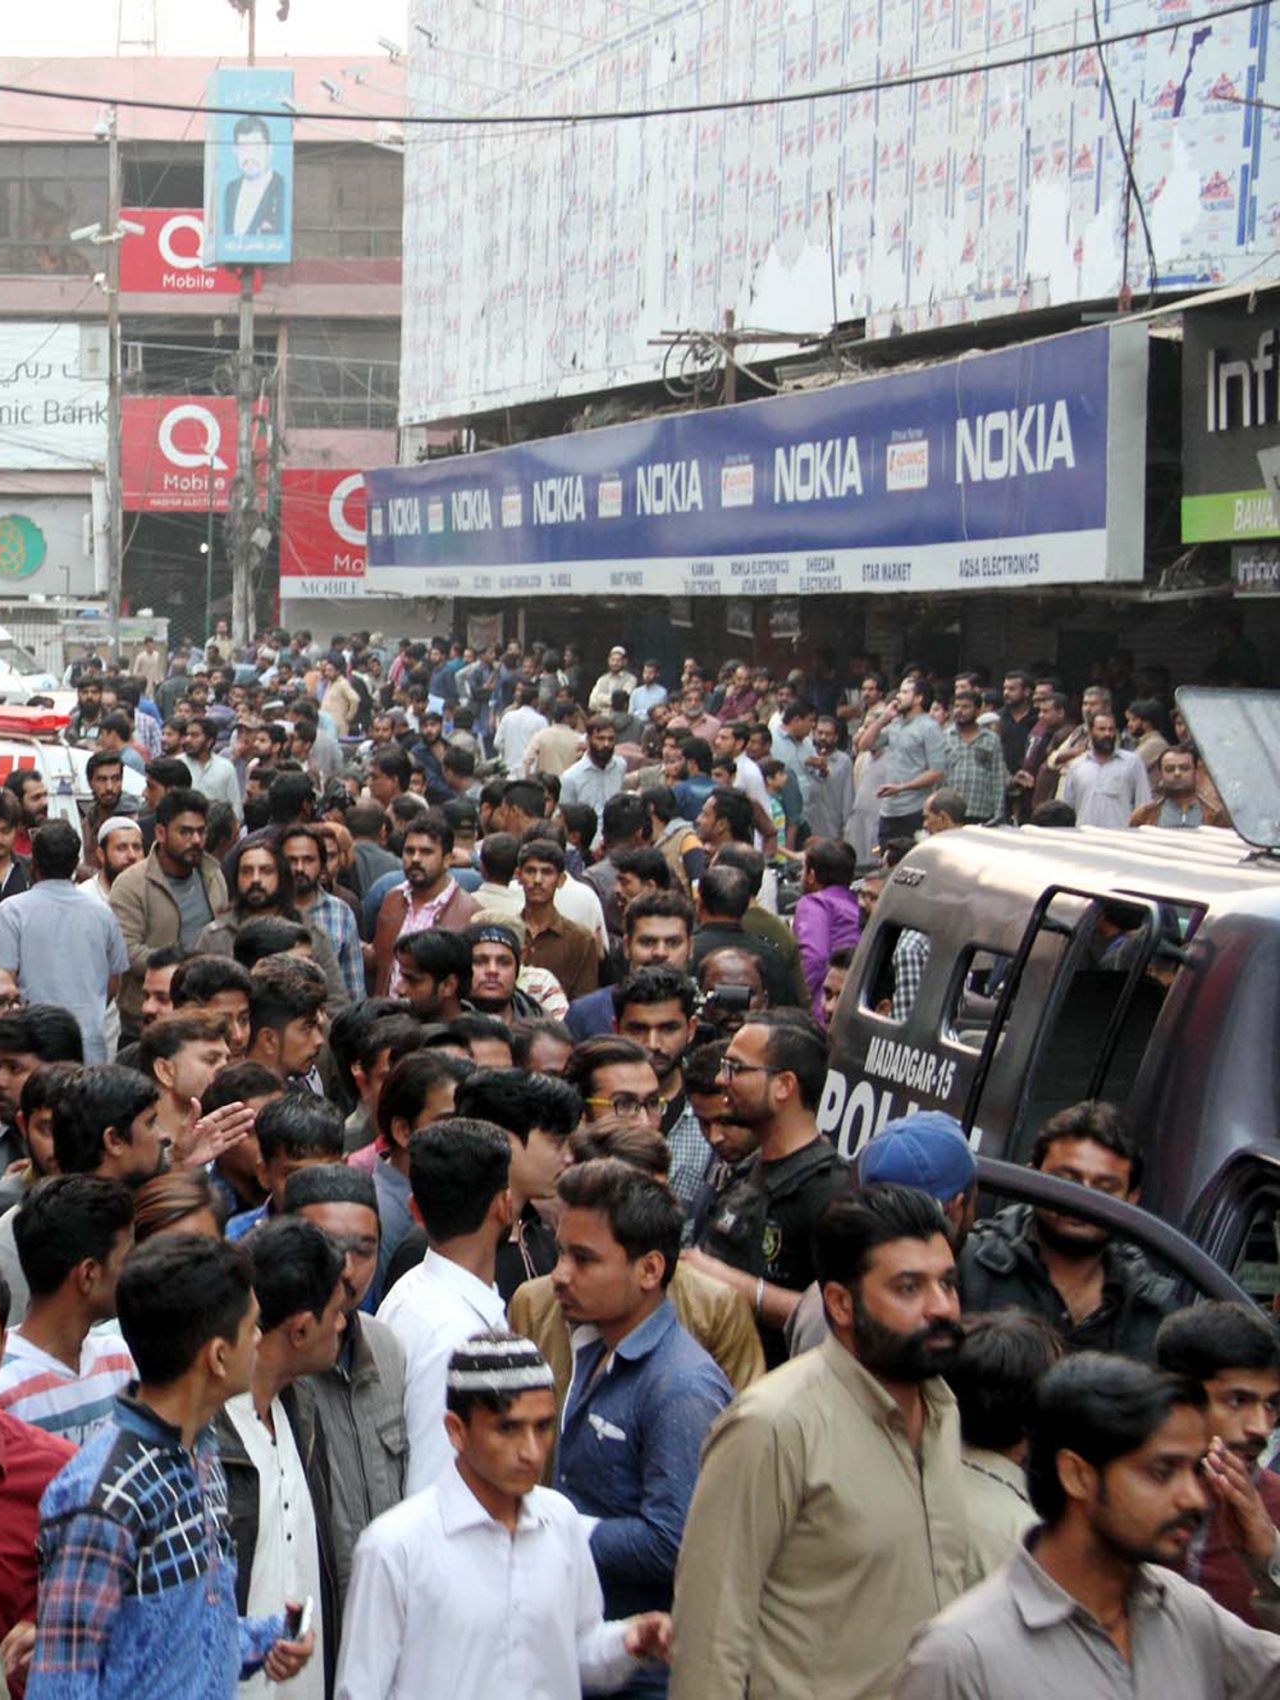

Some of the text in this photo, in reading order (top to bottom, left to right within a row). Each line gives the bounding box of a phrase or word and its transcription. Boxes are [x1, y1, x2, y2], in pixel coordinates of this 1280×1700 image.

[163, 273, 215, 289] Mobile
[1207, 329, 1280, 432] Inf
[43, 399, 108, 425] Bank
[158, 404, 229, 471] Q
[955, 399, 1076, 484] NOKIA
[163, 473, 224, 491] Mobie
[636, 458, 704, 516] NOKIA
[774, 436, 864, 504] NOKIA
[388, 497, 422, 535] NOKIA
[451, 488, 494, 532] NOKIA
[533, 474, 586, 526] NOKIA
[862, 562, 912, 583] STAR MARKET
[958, 553, 1040, 579] AQSA ELECTRONICS
[863, 1035, 957, 1100] MADADGAR-15
